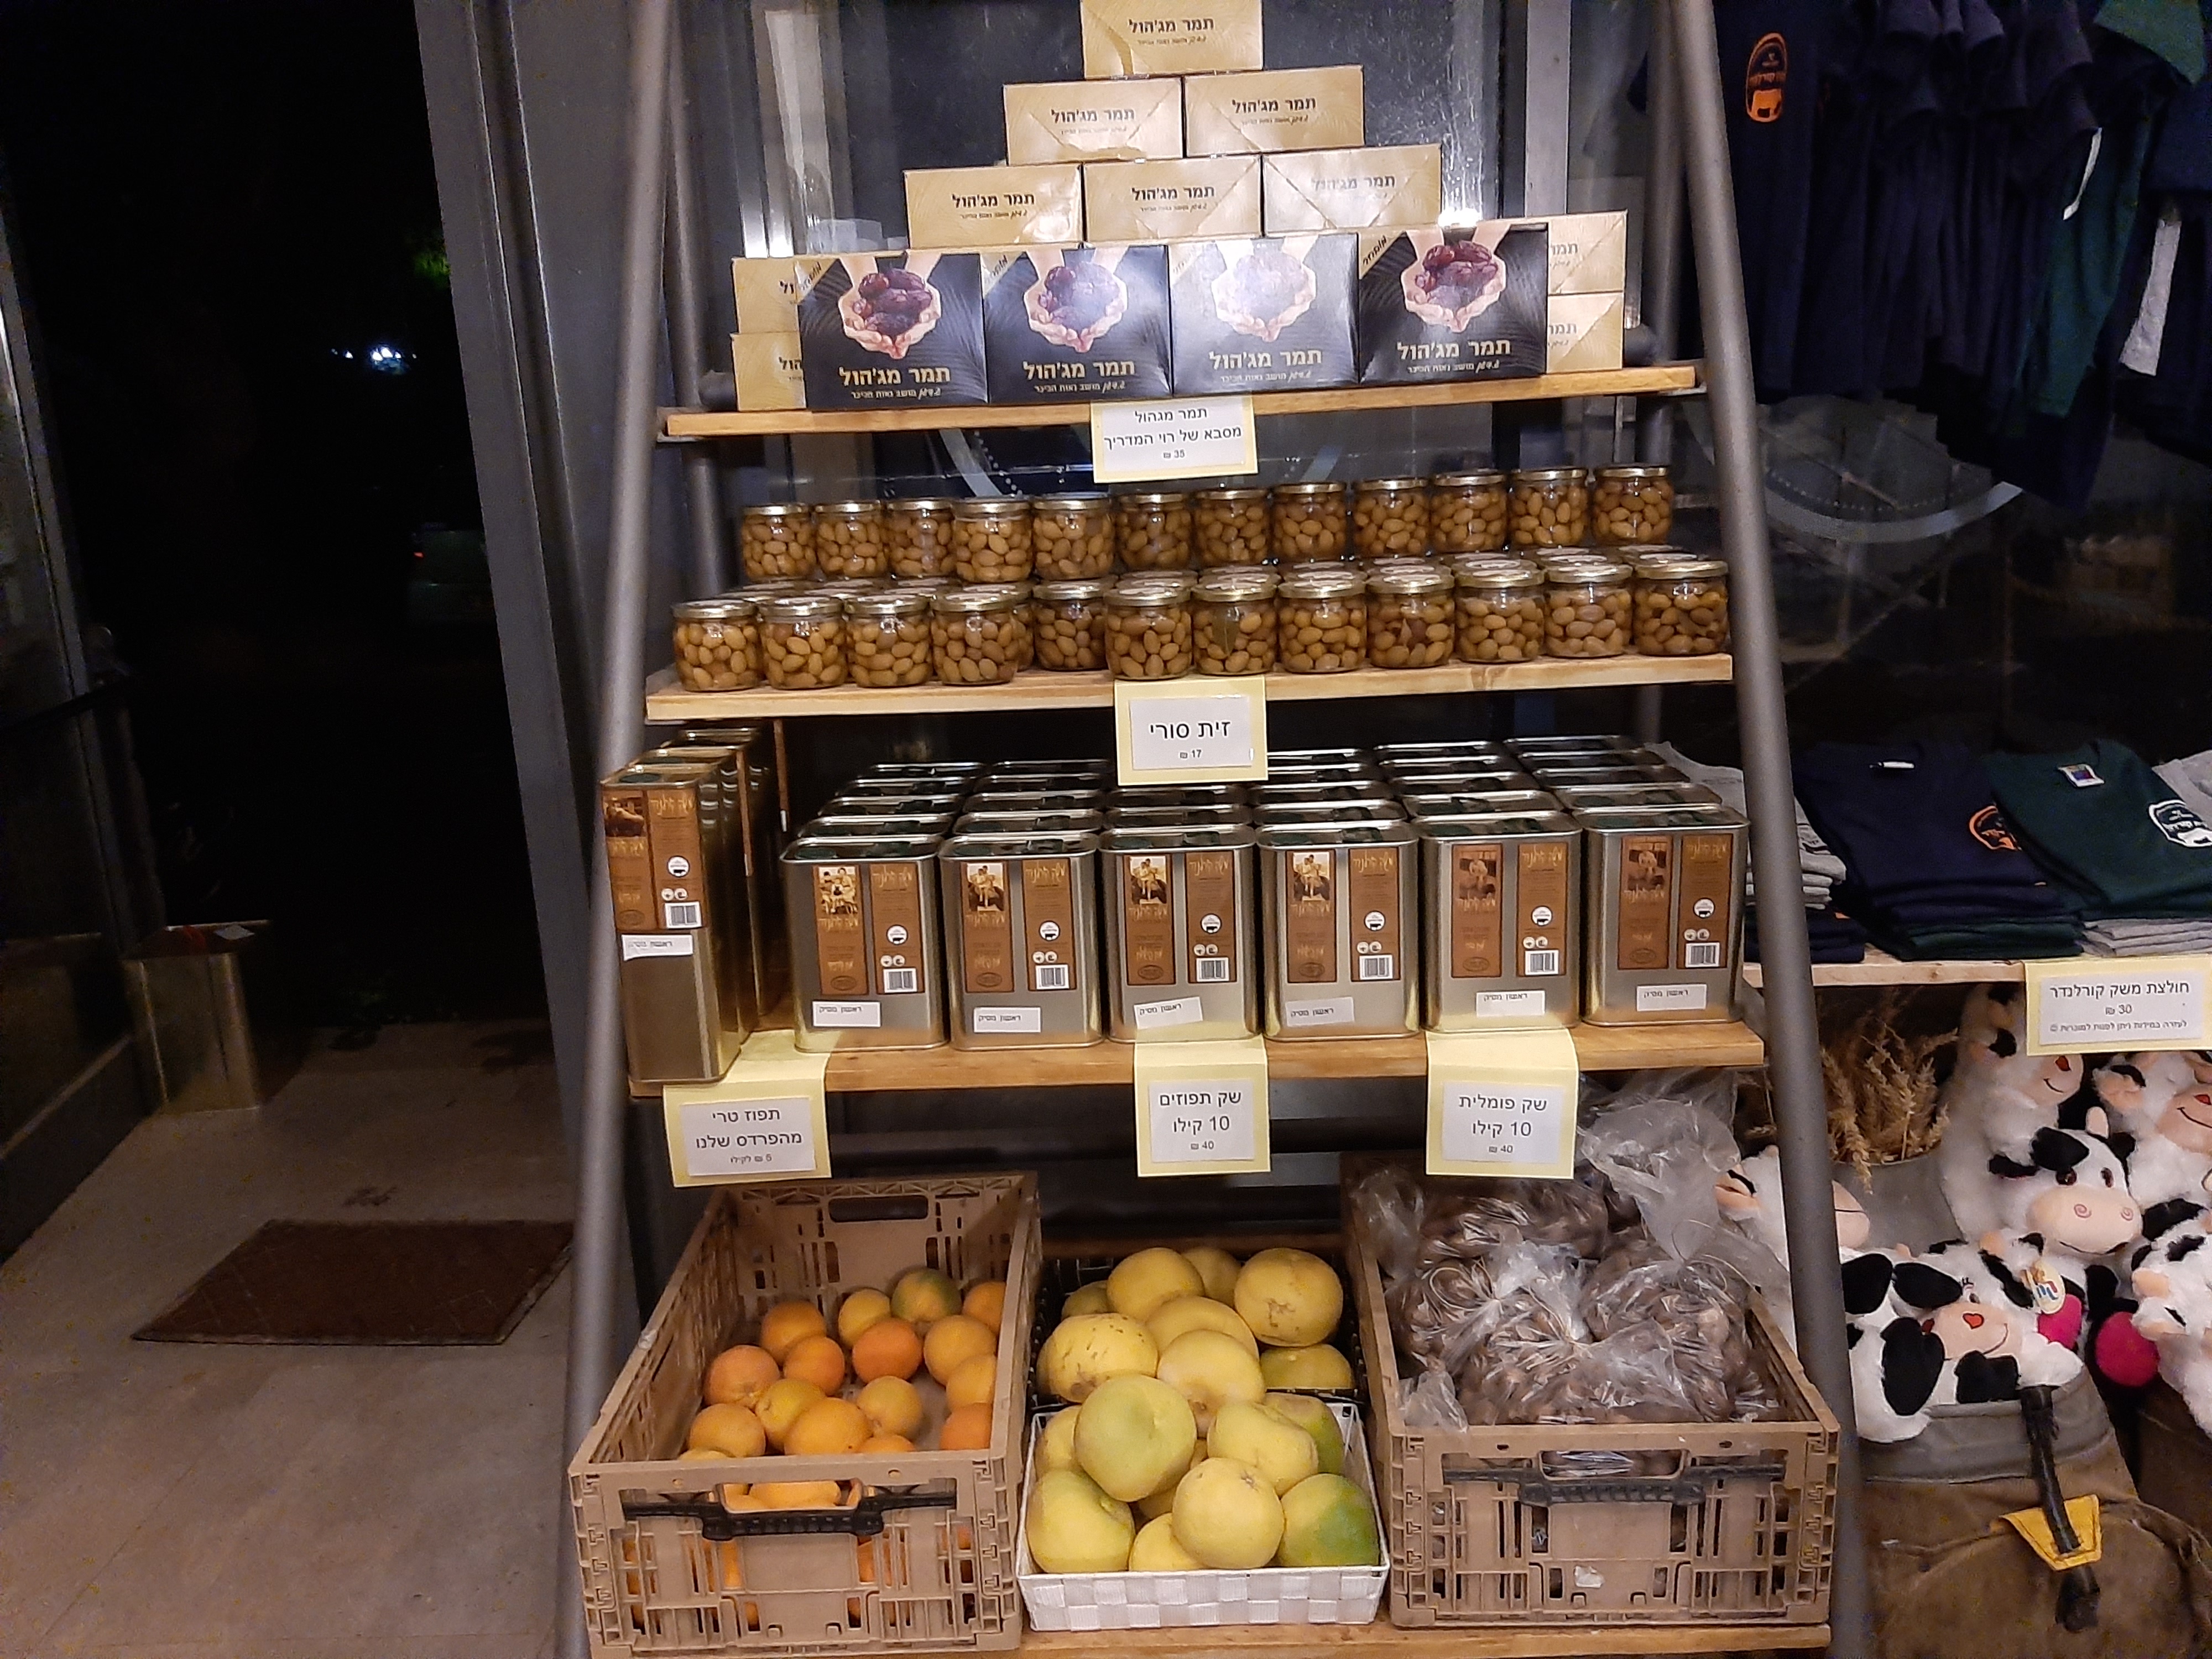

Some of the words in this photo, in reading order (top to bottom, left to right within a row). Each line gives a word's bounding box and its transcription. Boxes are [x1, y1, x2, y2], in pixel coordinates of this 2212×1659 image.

[1129, 19, 1176, 33] מג'הול
[1182, 18, 1214, 31] תמר
[1232, 99, 1279, 113] מג'הול
[1285, 97, 1316, 111] תמר
[1051, 109, 1098, 123] מג'הול
[1104, 109, 1134, 121] תמר
[1364, 175, 1395, 187] תמר
[1131, 187, 1178, 201] מג'הול
[1183, 186, 1214, 198] תמר
[952, 194, 998, 208] מג'הול
[1004, 194, 1035, 205] תמר
[1397, 341, 1460, 359] מג'הול
[1468, 340, 1511, 356] תמר
[1209, 351, 1271, 369] מג'הול
[1280, 349, 1322, 366] תמר
[909, 367, 951, 383] תמר
[1023, 361, 1085, 380] מג'הול
[1093, 361, 1135, 377] תמר
[839, 367, 901, 386] מג'הול
[1135, 410, 1173, 423] מגהול
[1178, 408, 1208, 419] תמר
[1159, 432, 1175, 444] רוי
[1179, 429, 1198, 441] של
[1204, 426, 1241, 440] מסבא
[1104, 435, 1154, 450] המדריך
[1150, 723, 1190, 739] סורי
[1198, 722, 1230, 737] זית
[1191, 749, 1202, 758] 17
[2049, 984, 2104, 1000] קורלנדר
[2110, 984, 2141, 998] משק
[2147, 980, 2189, 994] חולצת
[2105, 1006, 2115, 1015] ₪
[2119, 1004, 2132, 1015] 30
[1160, 1093, 1211, 1105] תפוזים
[1218, 1092, 1241, 1107] שק
[1459, 1094, 1515, 1109] פומלית
[1522, 1099, 1547, 1113] שק
[713, 1111, 739, 1123] טרי
[744, 1109, 780, 1121] תפוז
[1173, 1118, 1202, 1135] קילו
[1209, 1115, 1230, 1131] 10
[1473, 1120, 1503, 1138] קילו
[1510, 1121, 1532, 1136] 10
[696, 1135, 730, 1149] שלנו
[737, 1133, 802, 1146] מהפרדס
[1202, 1141, 1214, 1150] 40
[731, 1156, 752, 1165] לקילו
